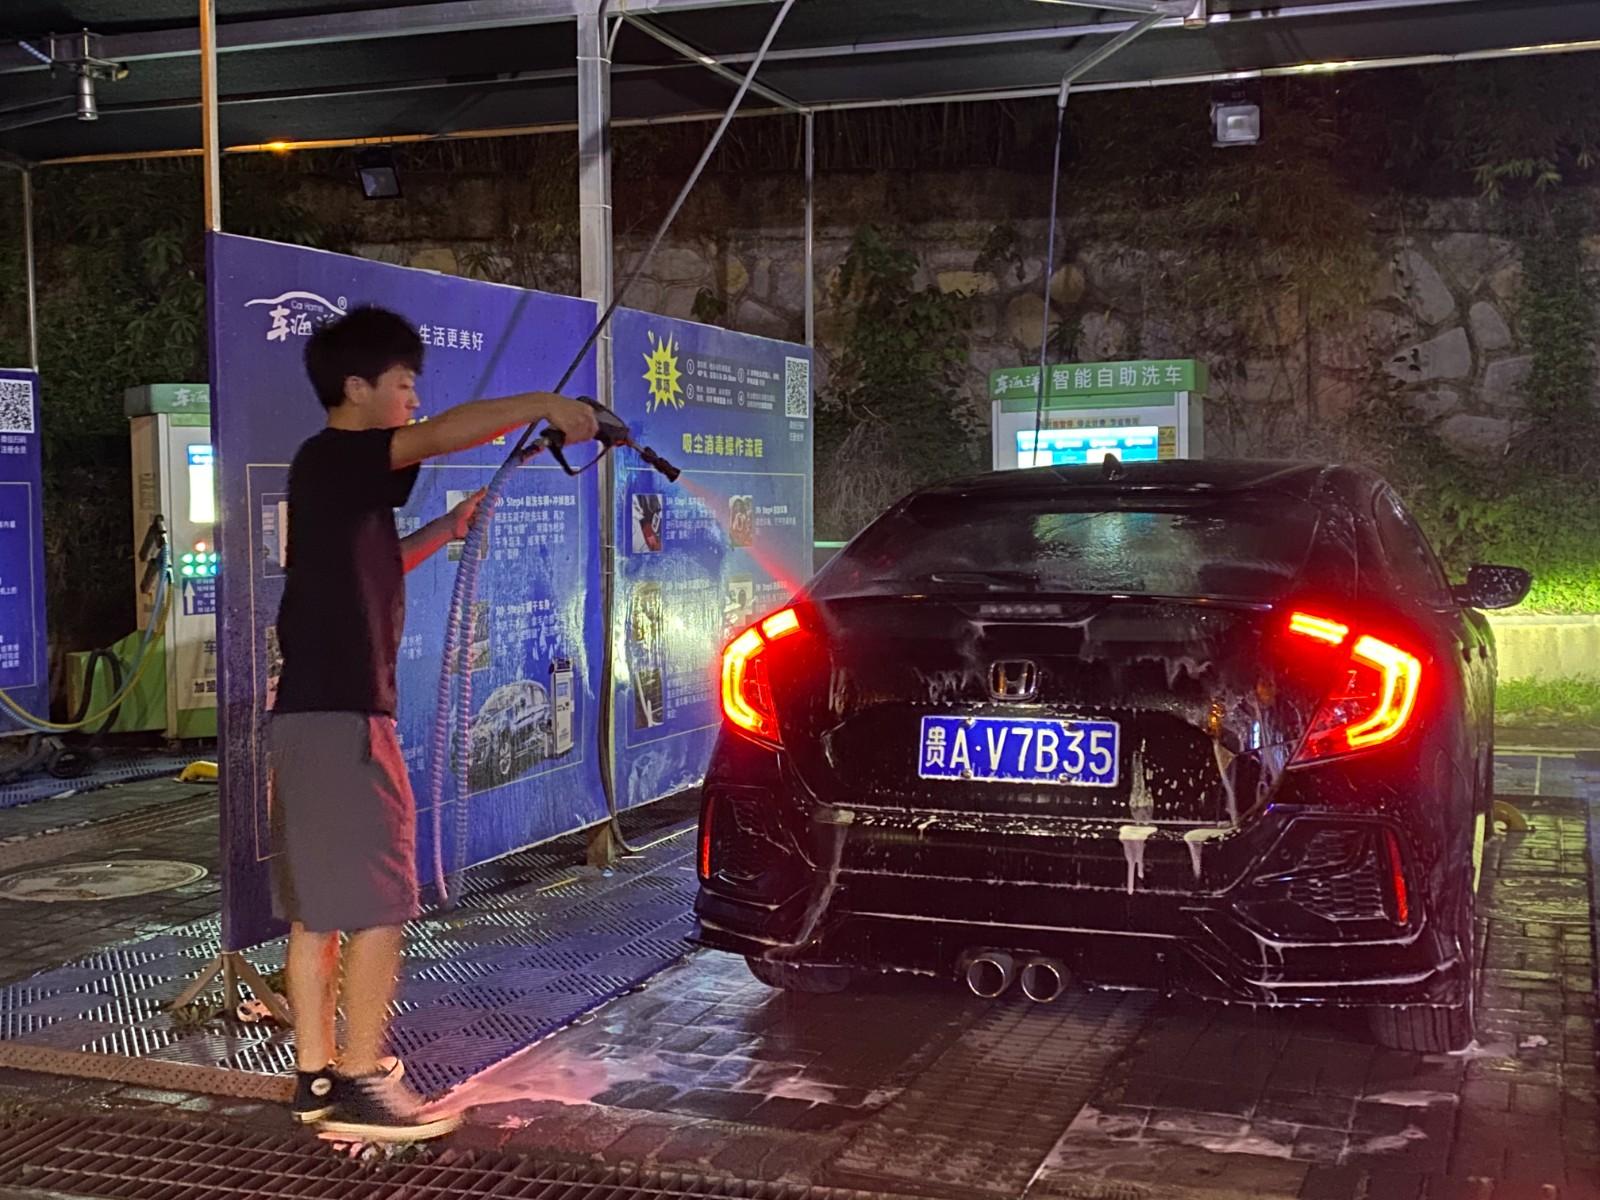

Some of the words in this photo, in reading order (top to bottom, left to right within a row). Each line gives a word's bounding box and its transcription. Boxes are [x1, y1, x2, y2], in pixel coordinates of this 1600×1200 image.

[419, 324, 484, 352] 生活更美好
[654, 359, 671, 380] 注意
[1052, 365, 1184, 391] 智能自助洗车
[682, 433, 764, 458] 吸尘消毒操作流程
[924, 725, 1113, 775] 贵A·V7B35
